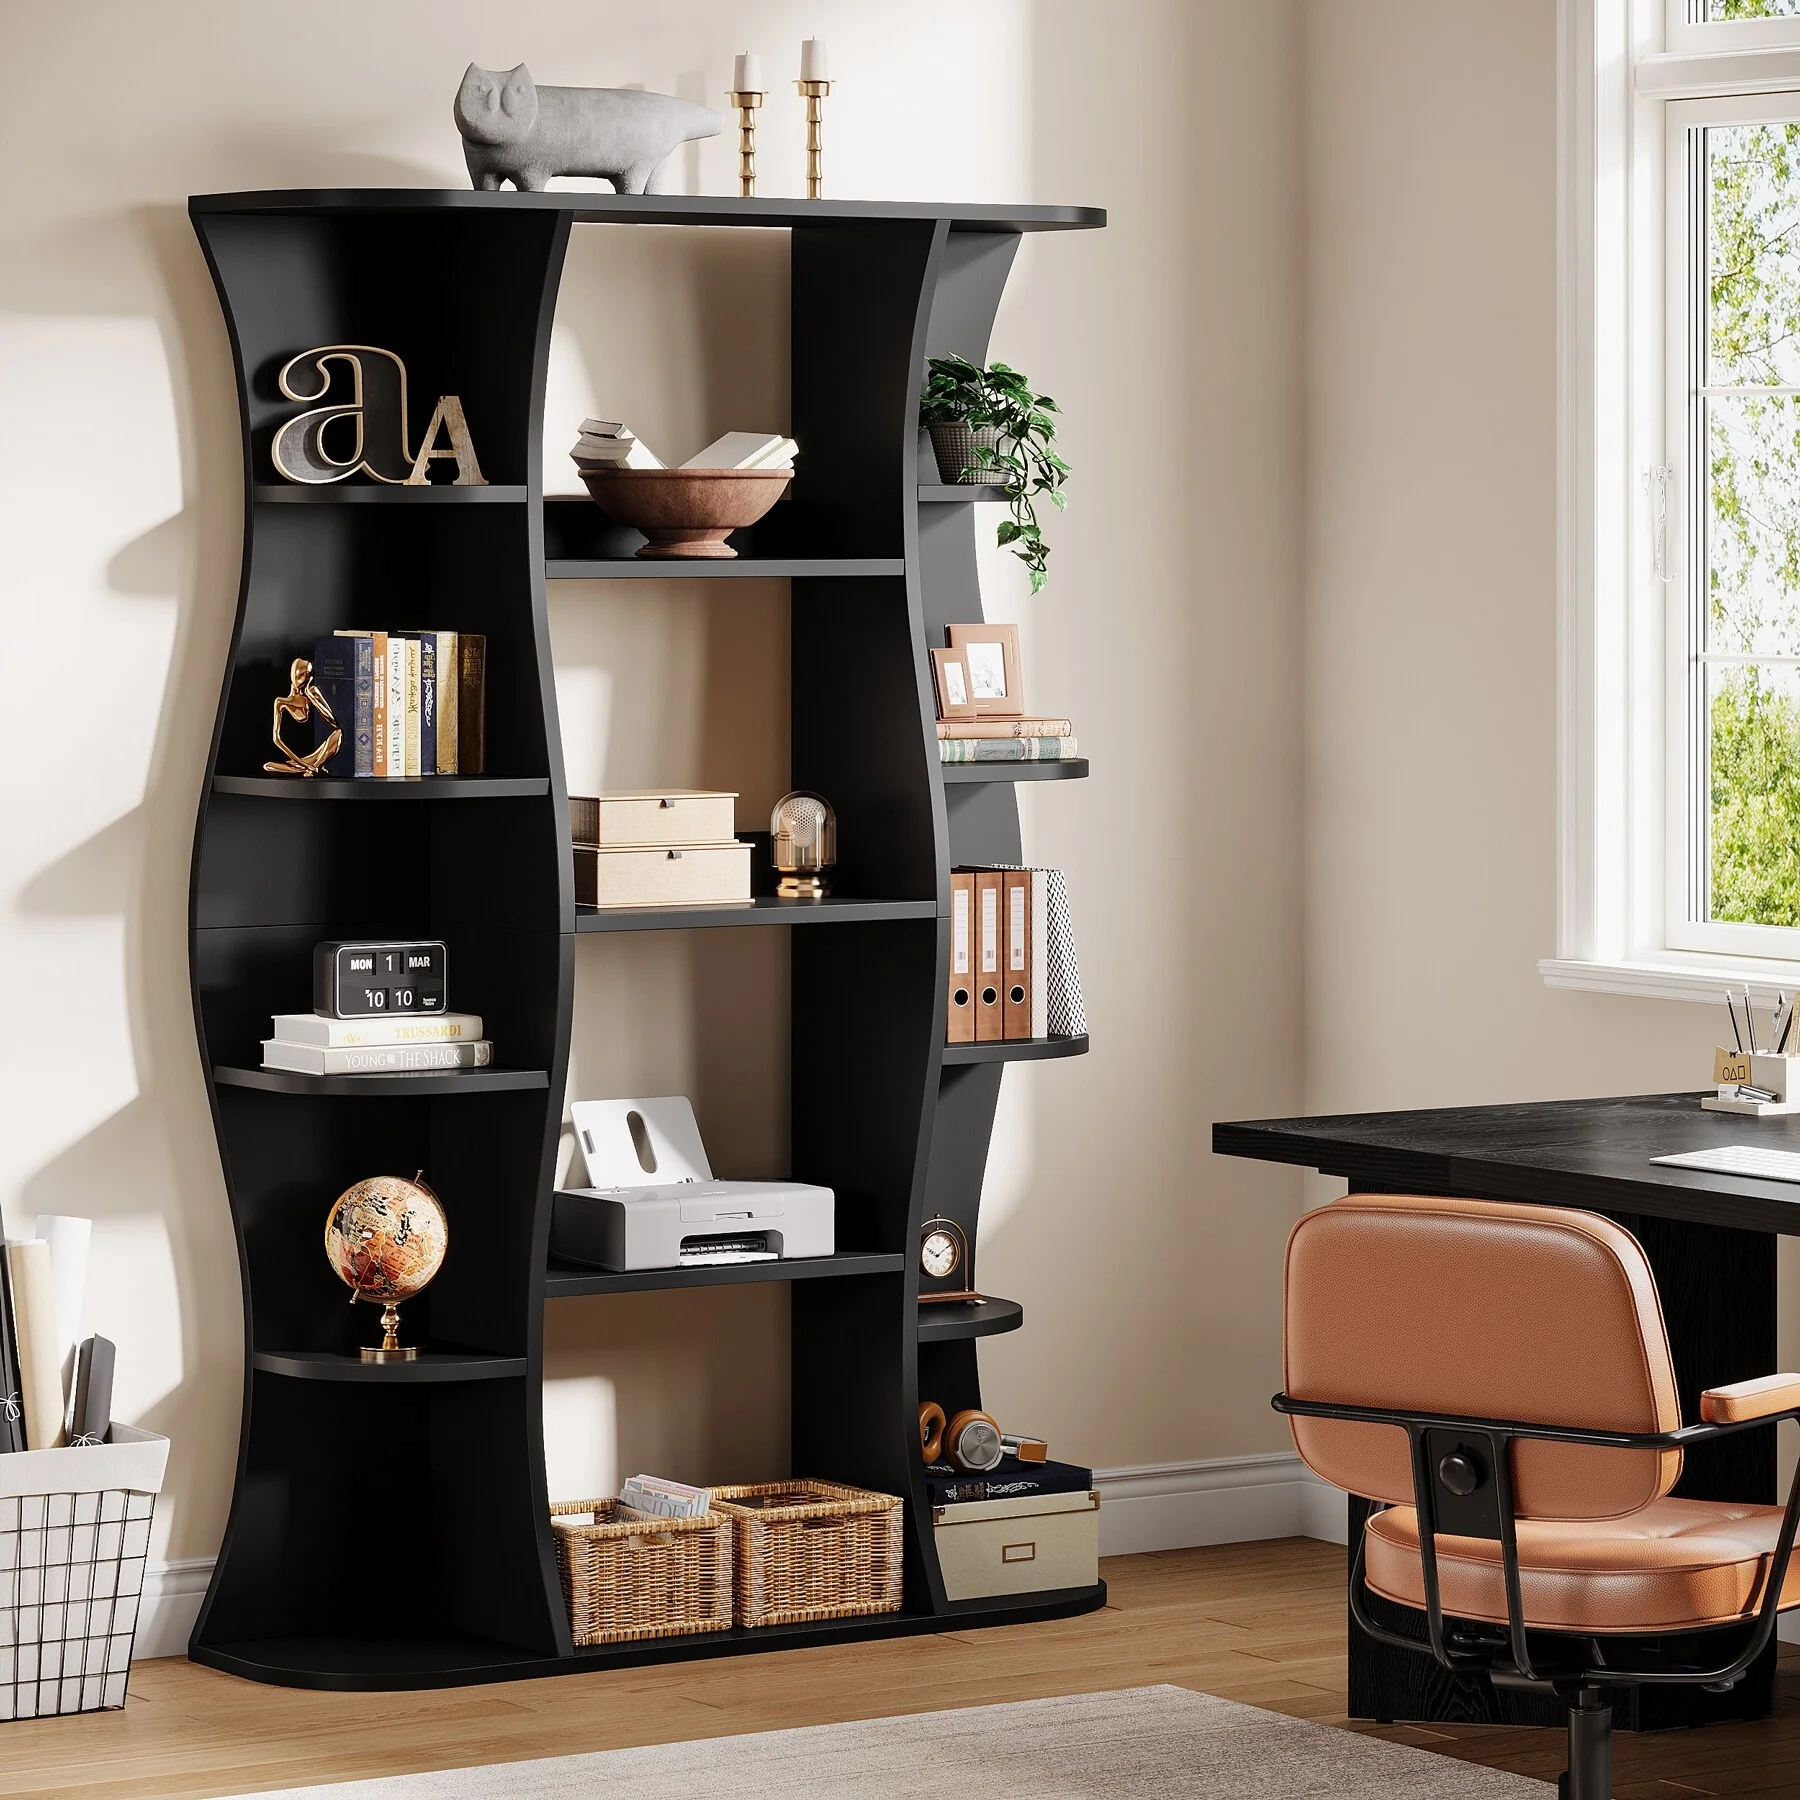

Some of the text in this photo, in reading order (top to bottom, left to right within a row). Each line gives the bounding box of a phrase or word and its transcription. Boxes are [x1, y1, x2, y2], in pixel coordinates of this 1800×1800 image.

[403, 395, 489, 485] A
[350, 955, 431, 972] MON 1 MAR
[366, 991, 384, 1008] 10
[395, 990, 413, 1006] 10
[395, 1024, 462, 1039] TRUSSARDI
[344, 1049, 461, 1069] YOUNG THE SHACK
